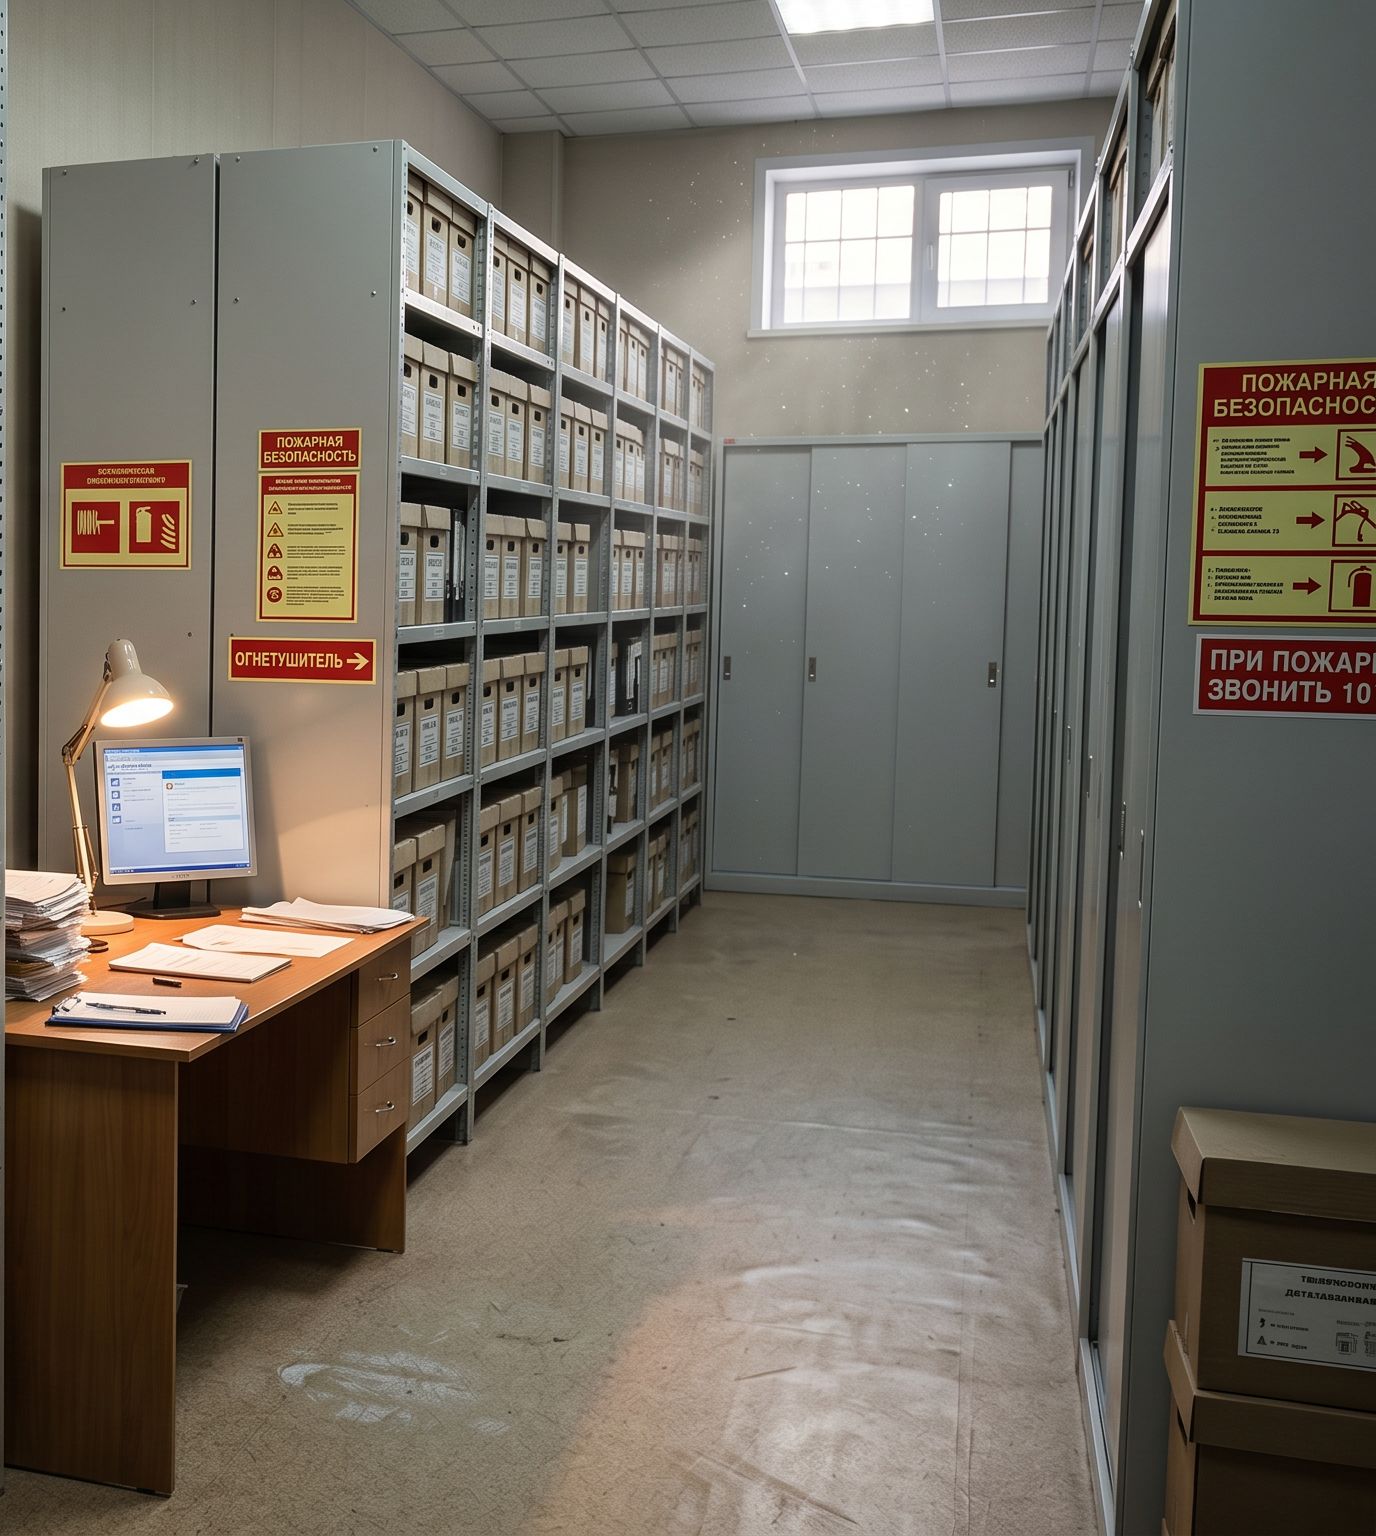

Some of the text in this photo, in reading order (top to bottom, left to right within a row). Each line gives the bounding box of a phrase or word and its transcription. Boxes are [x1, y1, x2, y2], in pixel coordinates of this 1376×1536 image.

[1241, 370, 1376, 393] ПОЖАРНАЯ
[276, 436, 343, 448] ПОЖАРНАЯ
[235, 651, 343, 668] ОГНЕТУШИТЕЛЬ
[1210, 649, 1263, 672] ПРИ
[1207, 678, 1332, 703] ЗВОНИТЬ
